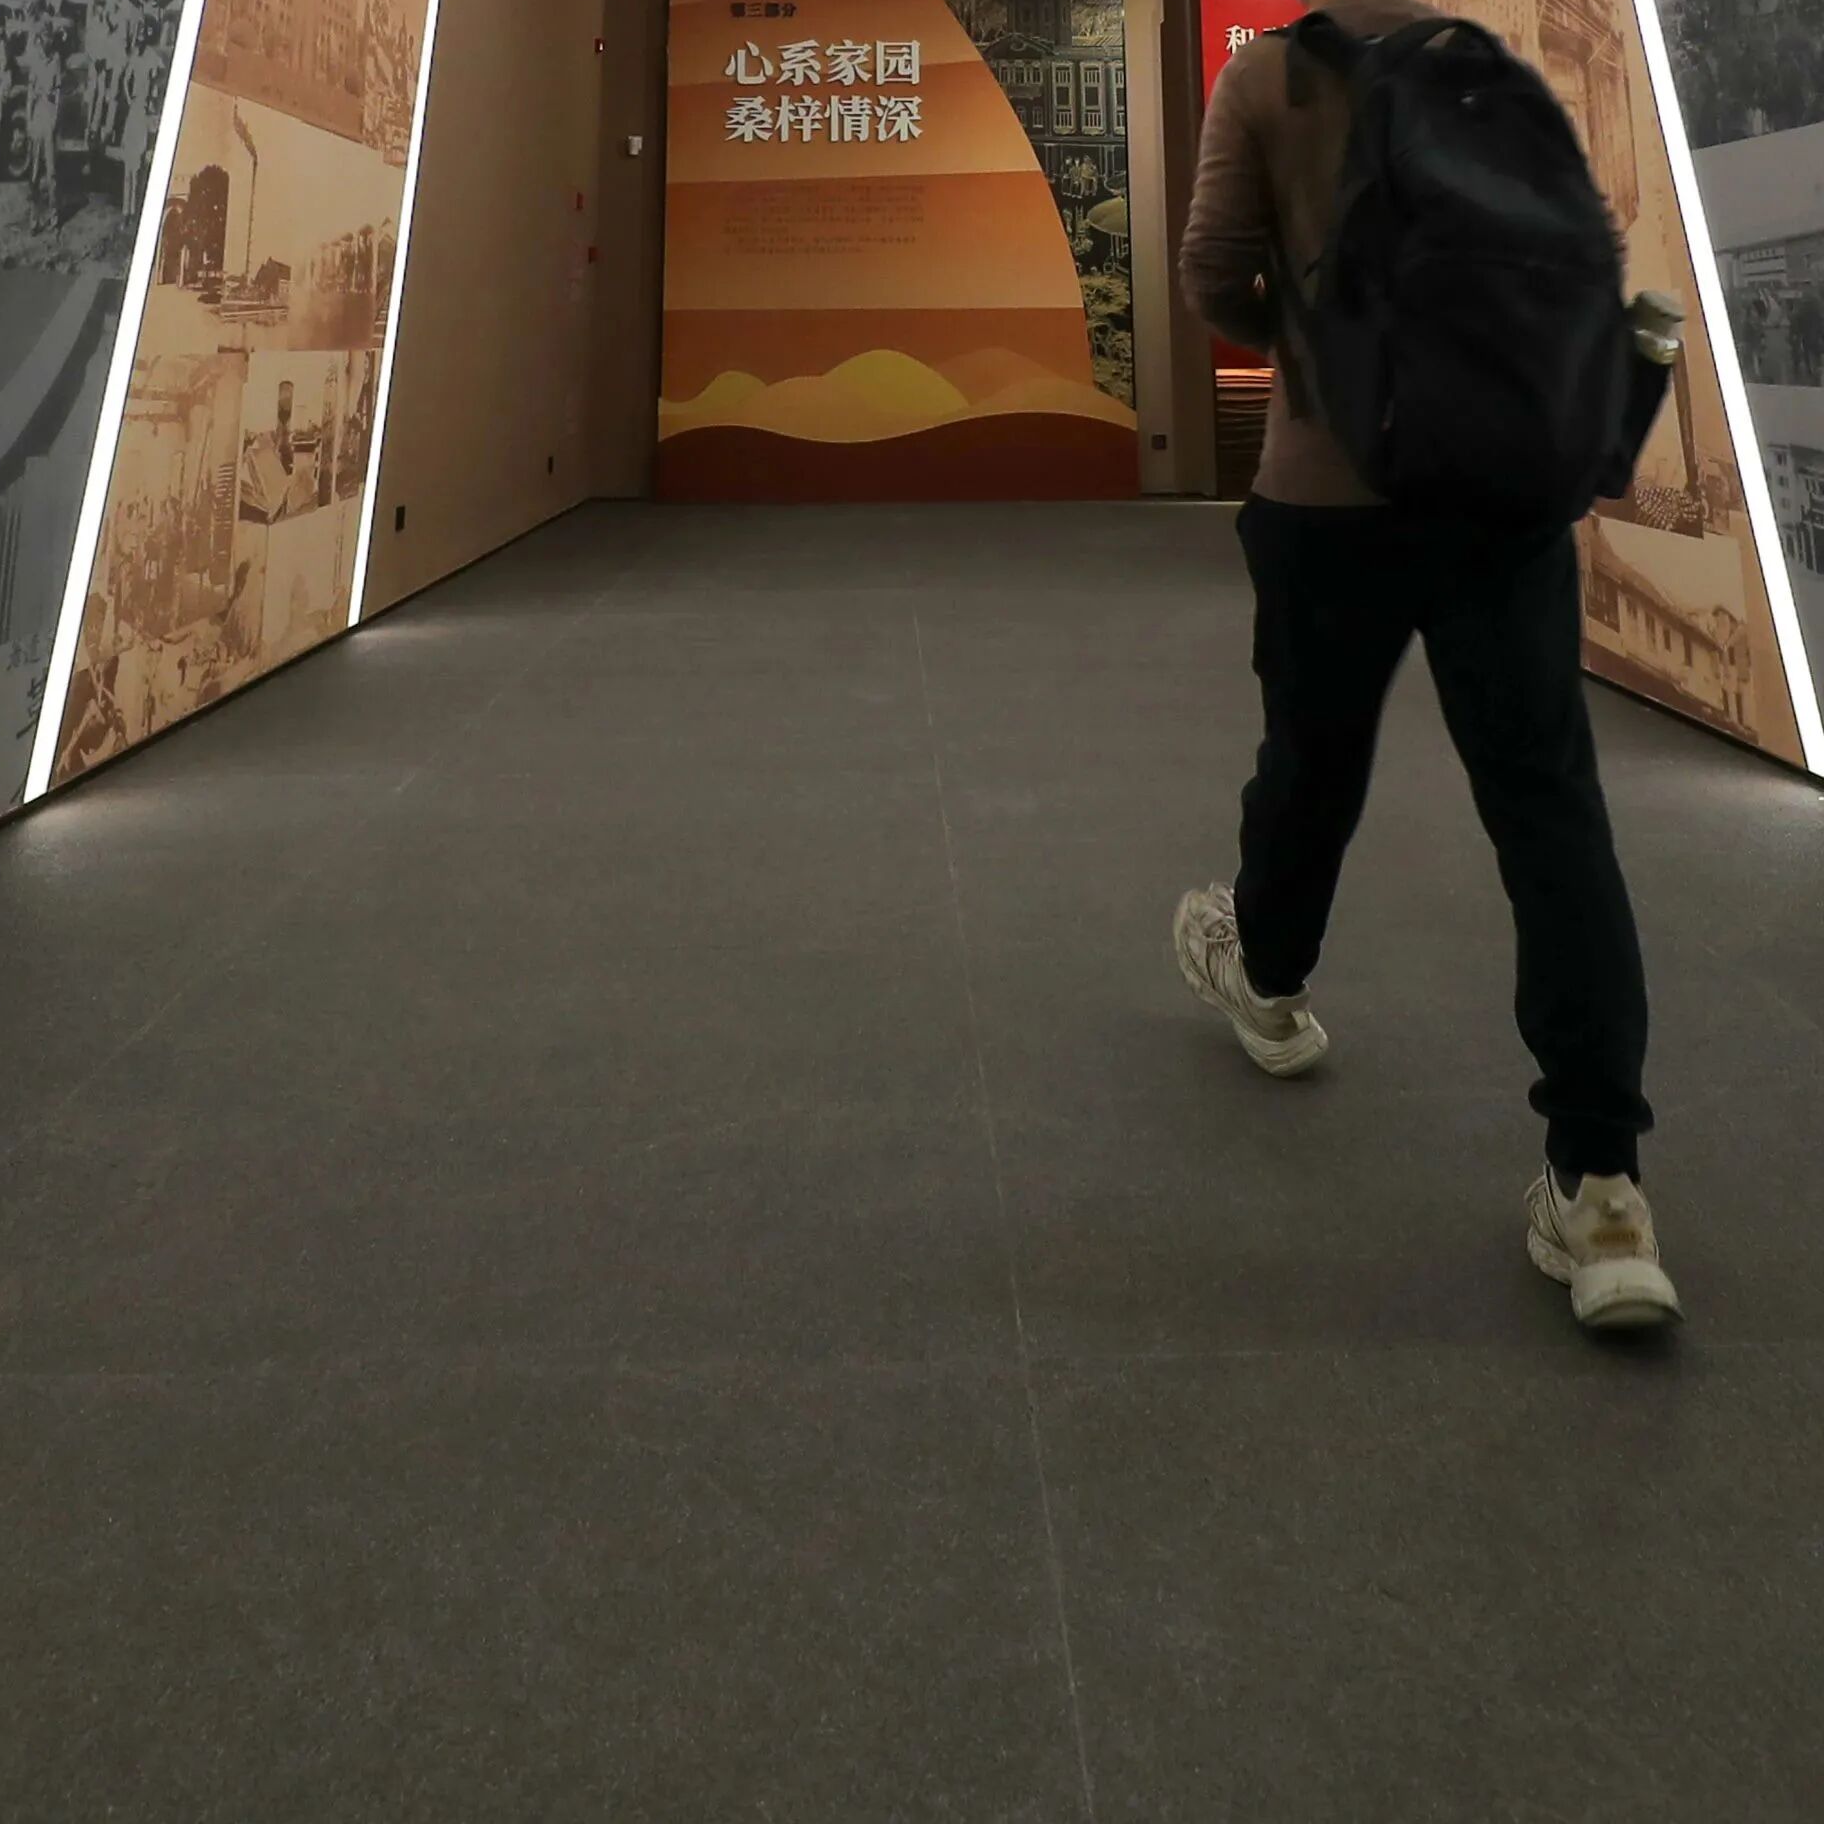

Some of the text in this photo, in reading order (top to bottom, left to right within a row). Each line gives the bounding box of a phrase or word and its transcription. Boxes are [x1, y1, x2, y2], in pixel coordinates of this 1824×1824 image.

[725, 39, 921, 86] 心系家园
[725, 94, 923, 143] 桑梓情深
